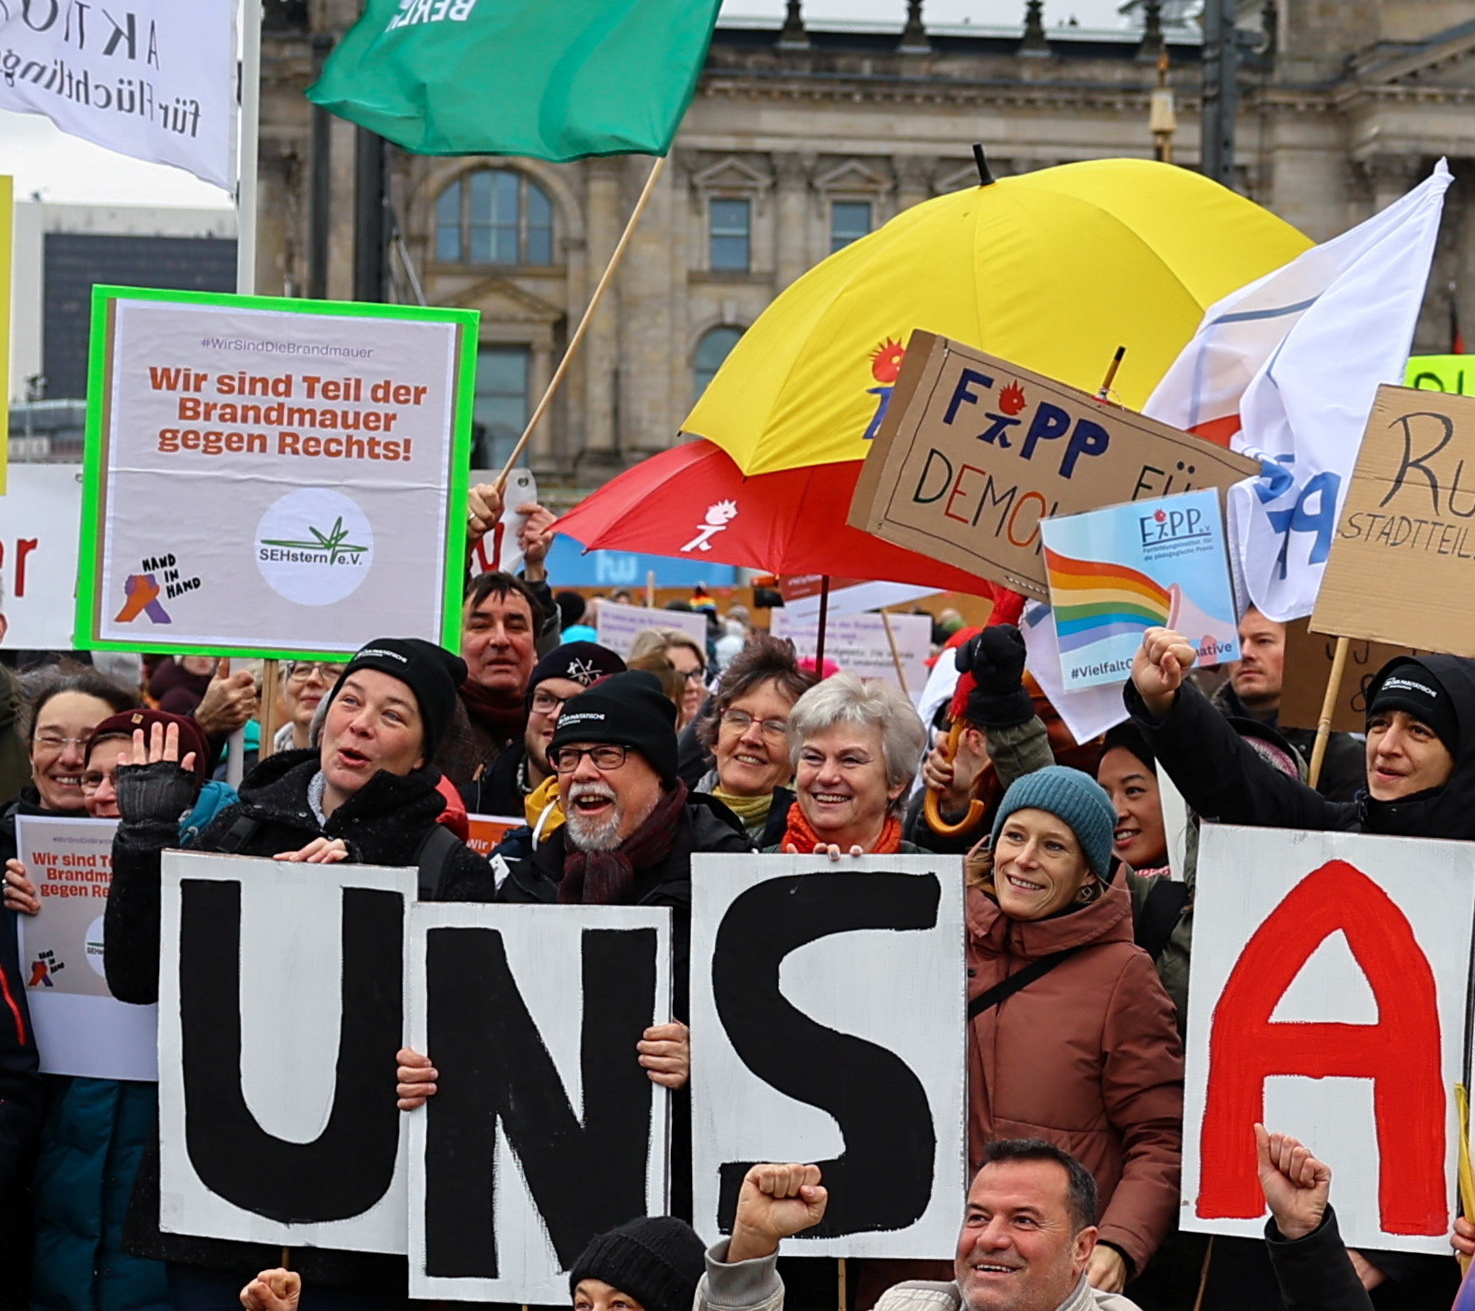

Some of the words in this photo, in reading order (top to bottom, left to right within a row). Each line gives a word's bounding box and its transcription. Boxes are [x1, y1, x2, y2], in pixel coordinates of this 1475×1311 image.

[200, 338, 374, 358] #WirSindDieBrandmauer
[149, 367, 209, 392] Wir
[216, 372, 292, 398] sind
[302, 375, 362, 402] Teil
[370, 379, 427, 406] der
[178, 397, 397, 432] Brandmauer
[158, 428, 267, 455] gegen
[277, 432, 412, 462] Rechts!
[142, 553, 176, 572] HAND
[259, 549, 328, 564] SEHstern
[337, 553, 362, 566] e.V.
[164, 569, 179, 583] IN
[166, 577, 201, 599] HAND
[33, 852, 58, 866] Wir
[62, 853, 96, 867] sind
[40, 884, 89, 898] gegen
[179, 871, 941, 1279] UNS
